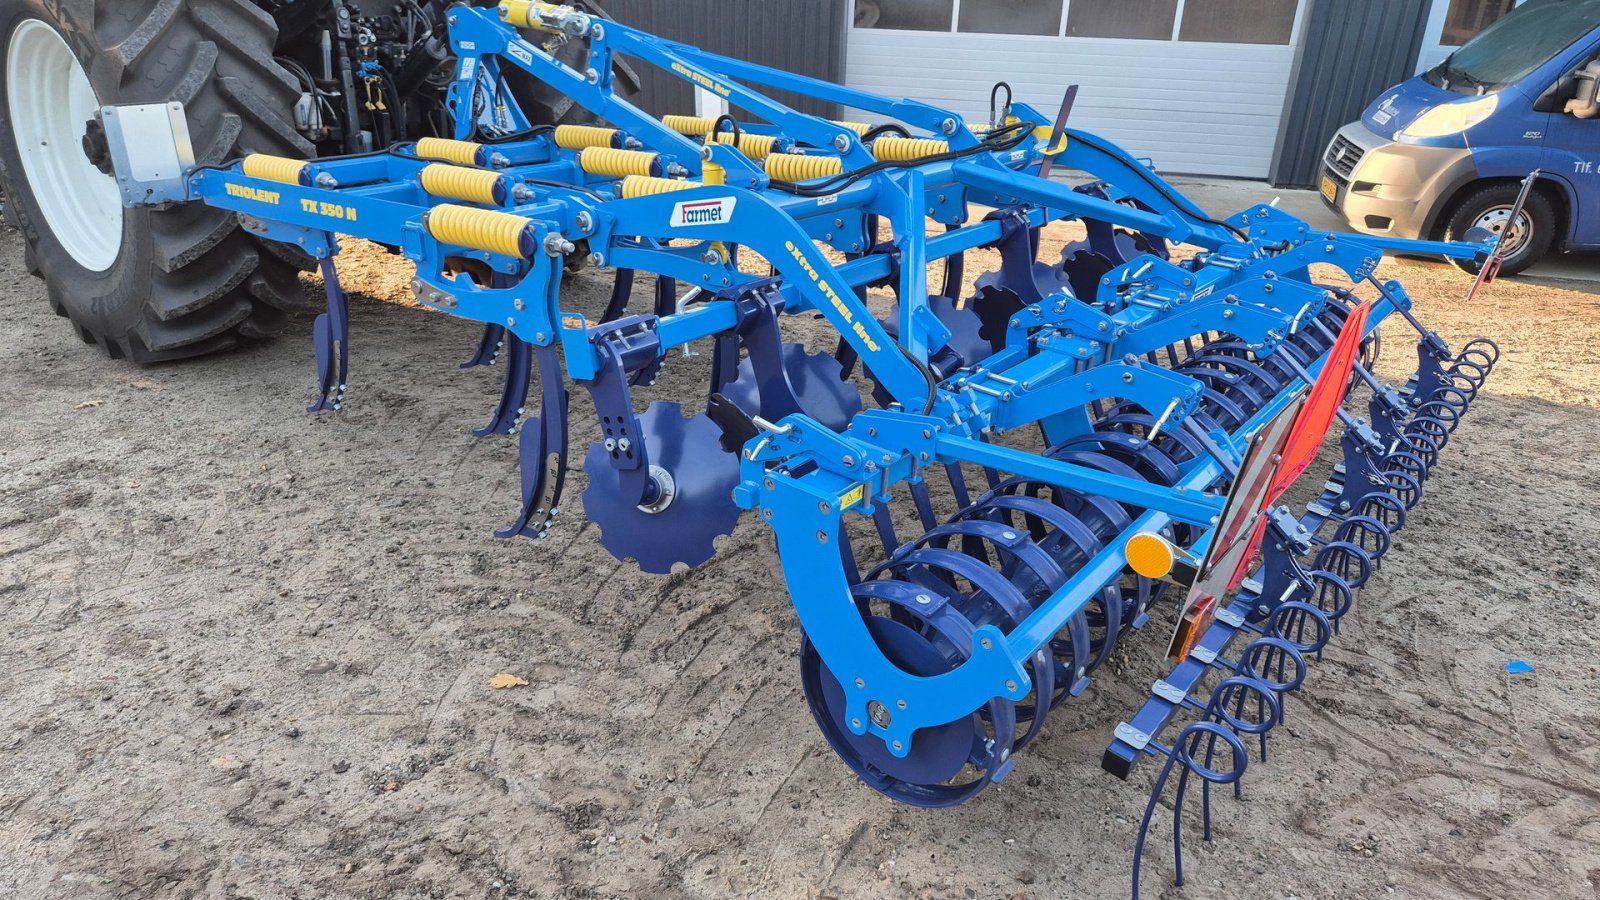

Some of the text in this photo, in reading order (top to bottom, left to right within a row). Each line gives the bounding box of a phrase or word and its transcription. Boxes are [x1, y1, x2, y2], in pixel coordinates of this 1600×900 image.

[692, 72, 713, 89] STEEL
[1573, 161, 1592, 174] Tlf.
[225, 183, 280, 204] TRIOLENT
[301, 198, 357, 221] TX 350 N
[681, 201, 722, 223] Farmet
[818, 279, 853, 324] STEEL
